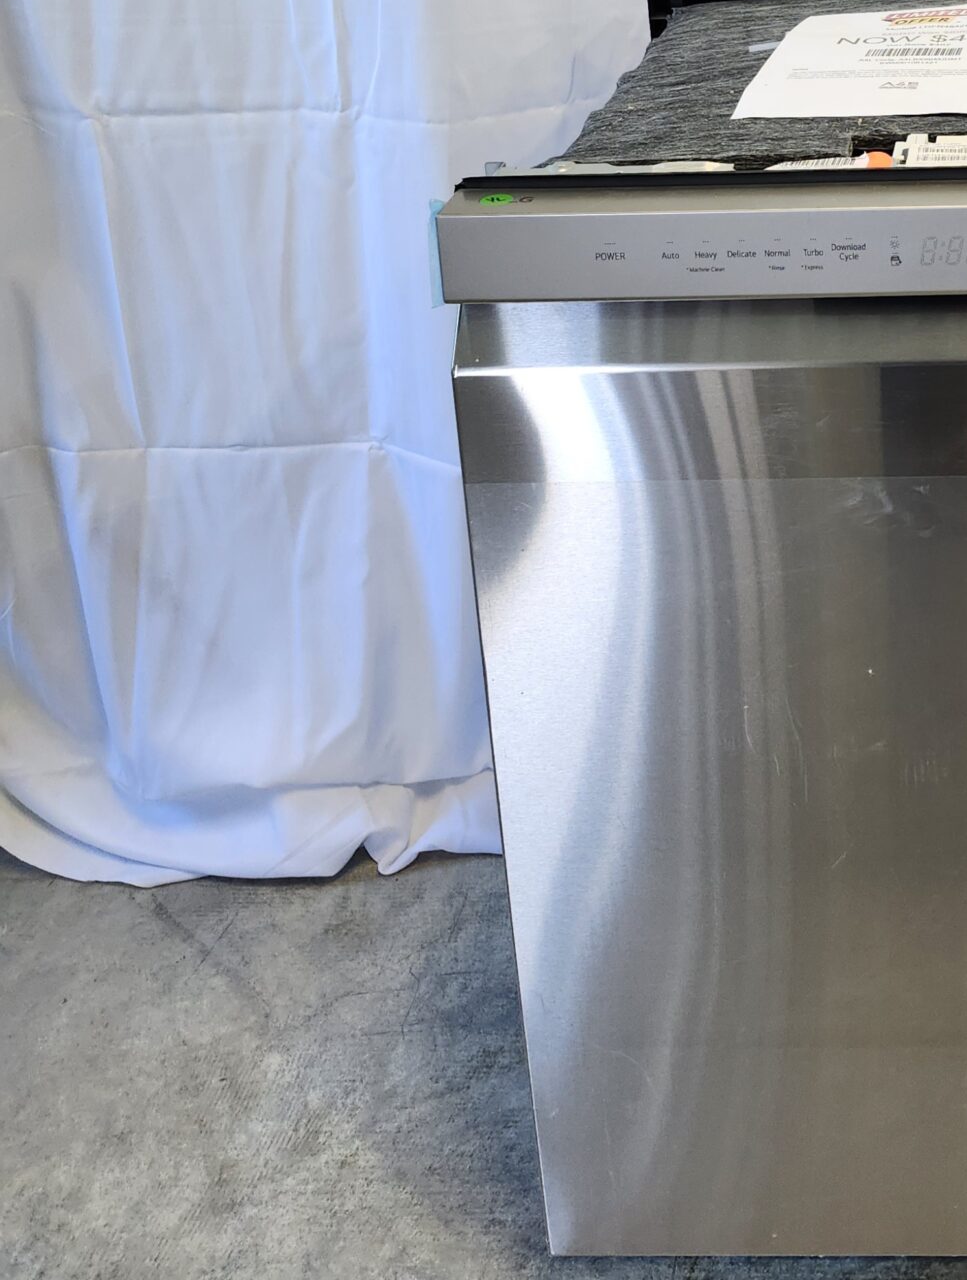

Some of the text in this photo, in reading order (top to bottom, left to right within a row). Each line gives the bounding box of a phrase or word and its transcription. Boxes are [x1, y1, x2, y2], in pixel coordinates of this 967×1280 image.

[894, 17, 950, 25] OFFER
[836, 35, 920, 45] NOW
[831, 242, 866, 252] Download
[595, 251, 626, 261] POWER
[661, 251, 680, 260] Auto
[694, 251, 717, 260] Heavy
[727, 250, 757, 258] Delicate
[764, 249, 791, 257] Normal
[803, 248, 824, 257] Turbo
[839, 251, 859, 262] Cycle
